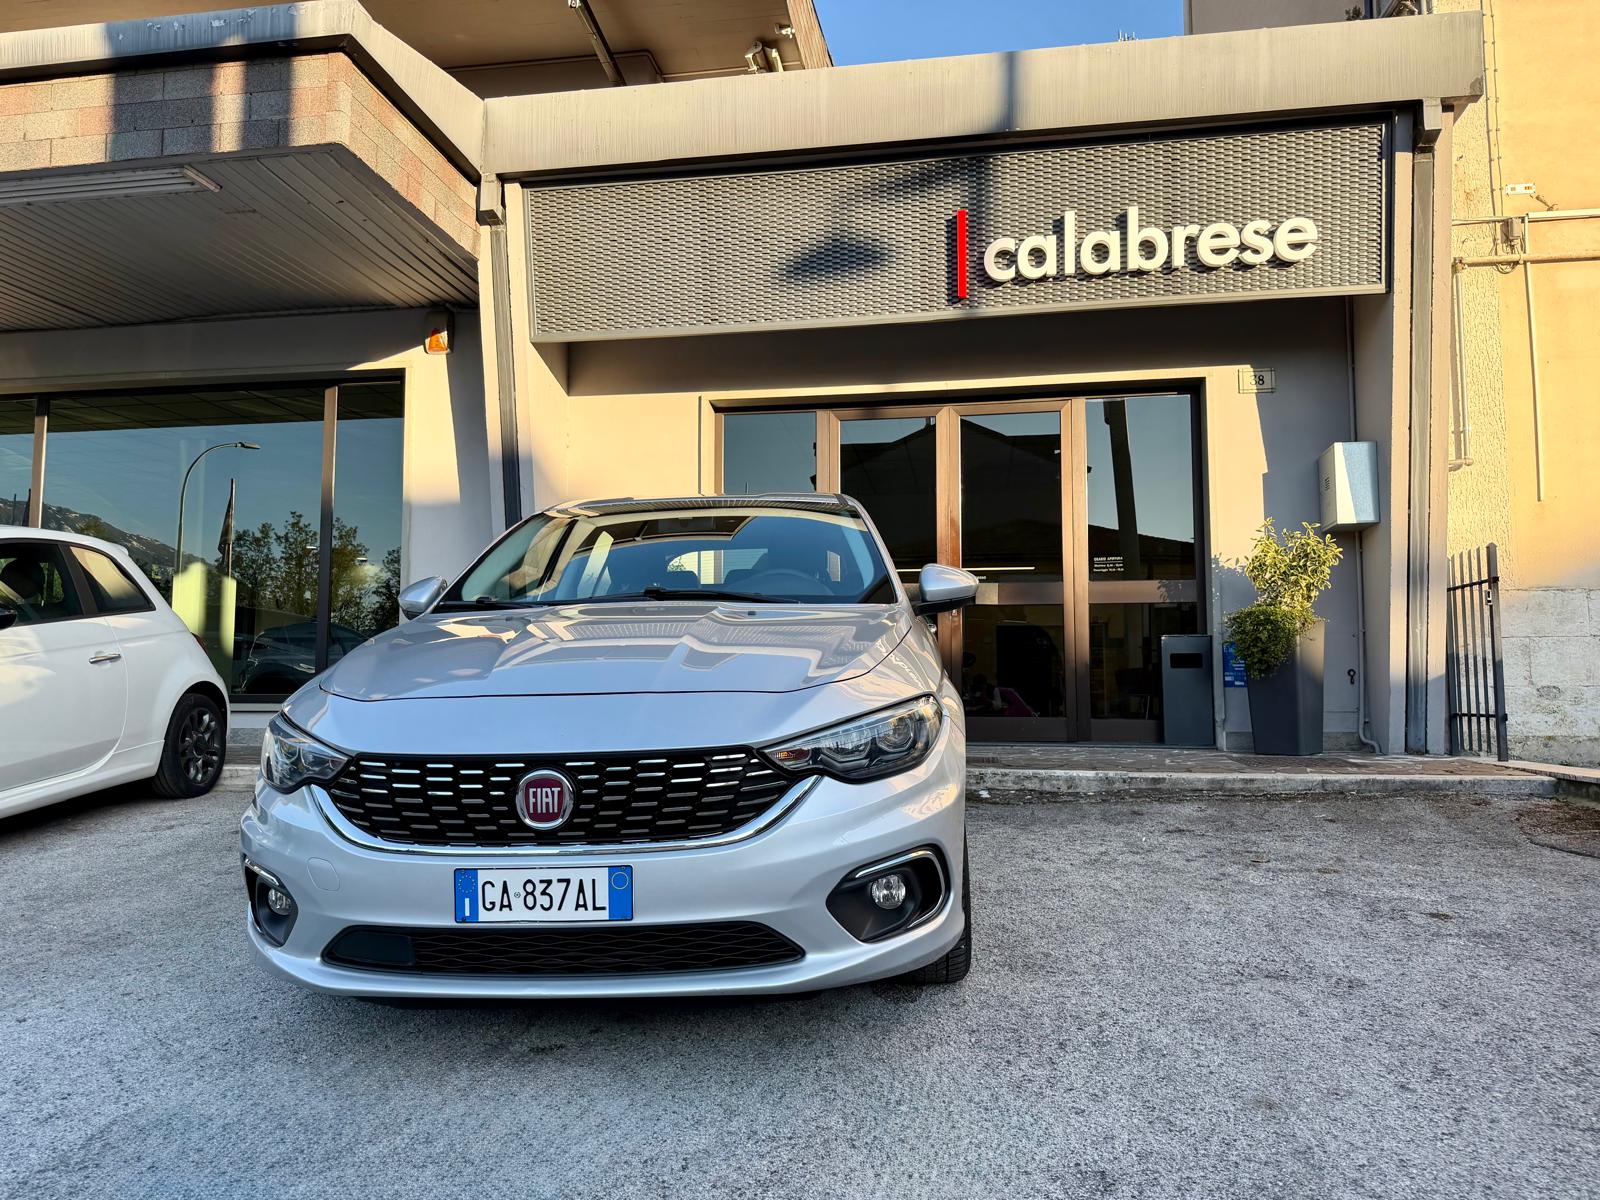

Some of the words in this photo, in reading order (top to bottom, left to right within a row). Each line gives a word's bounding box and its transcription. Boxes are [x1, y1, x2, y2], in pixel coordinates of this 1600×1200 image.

[983, 205, 1319, 283] calabrese
[1249, 374, 1265, 386] 38
[528, 787, 561, 814] FIAT
